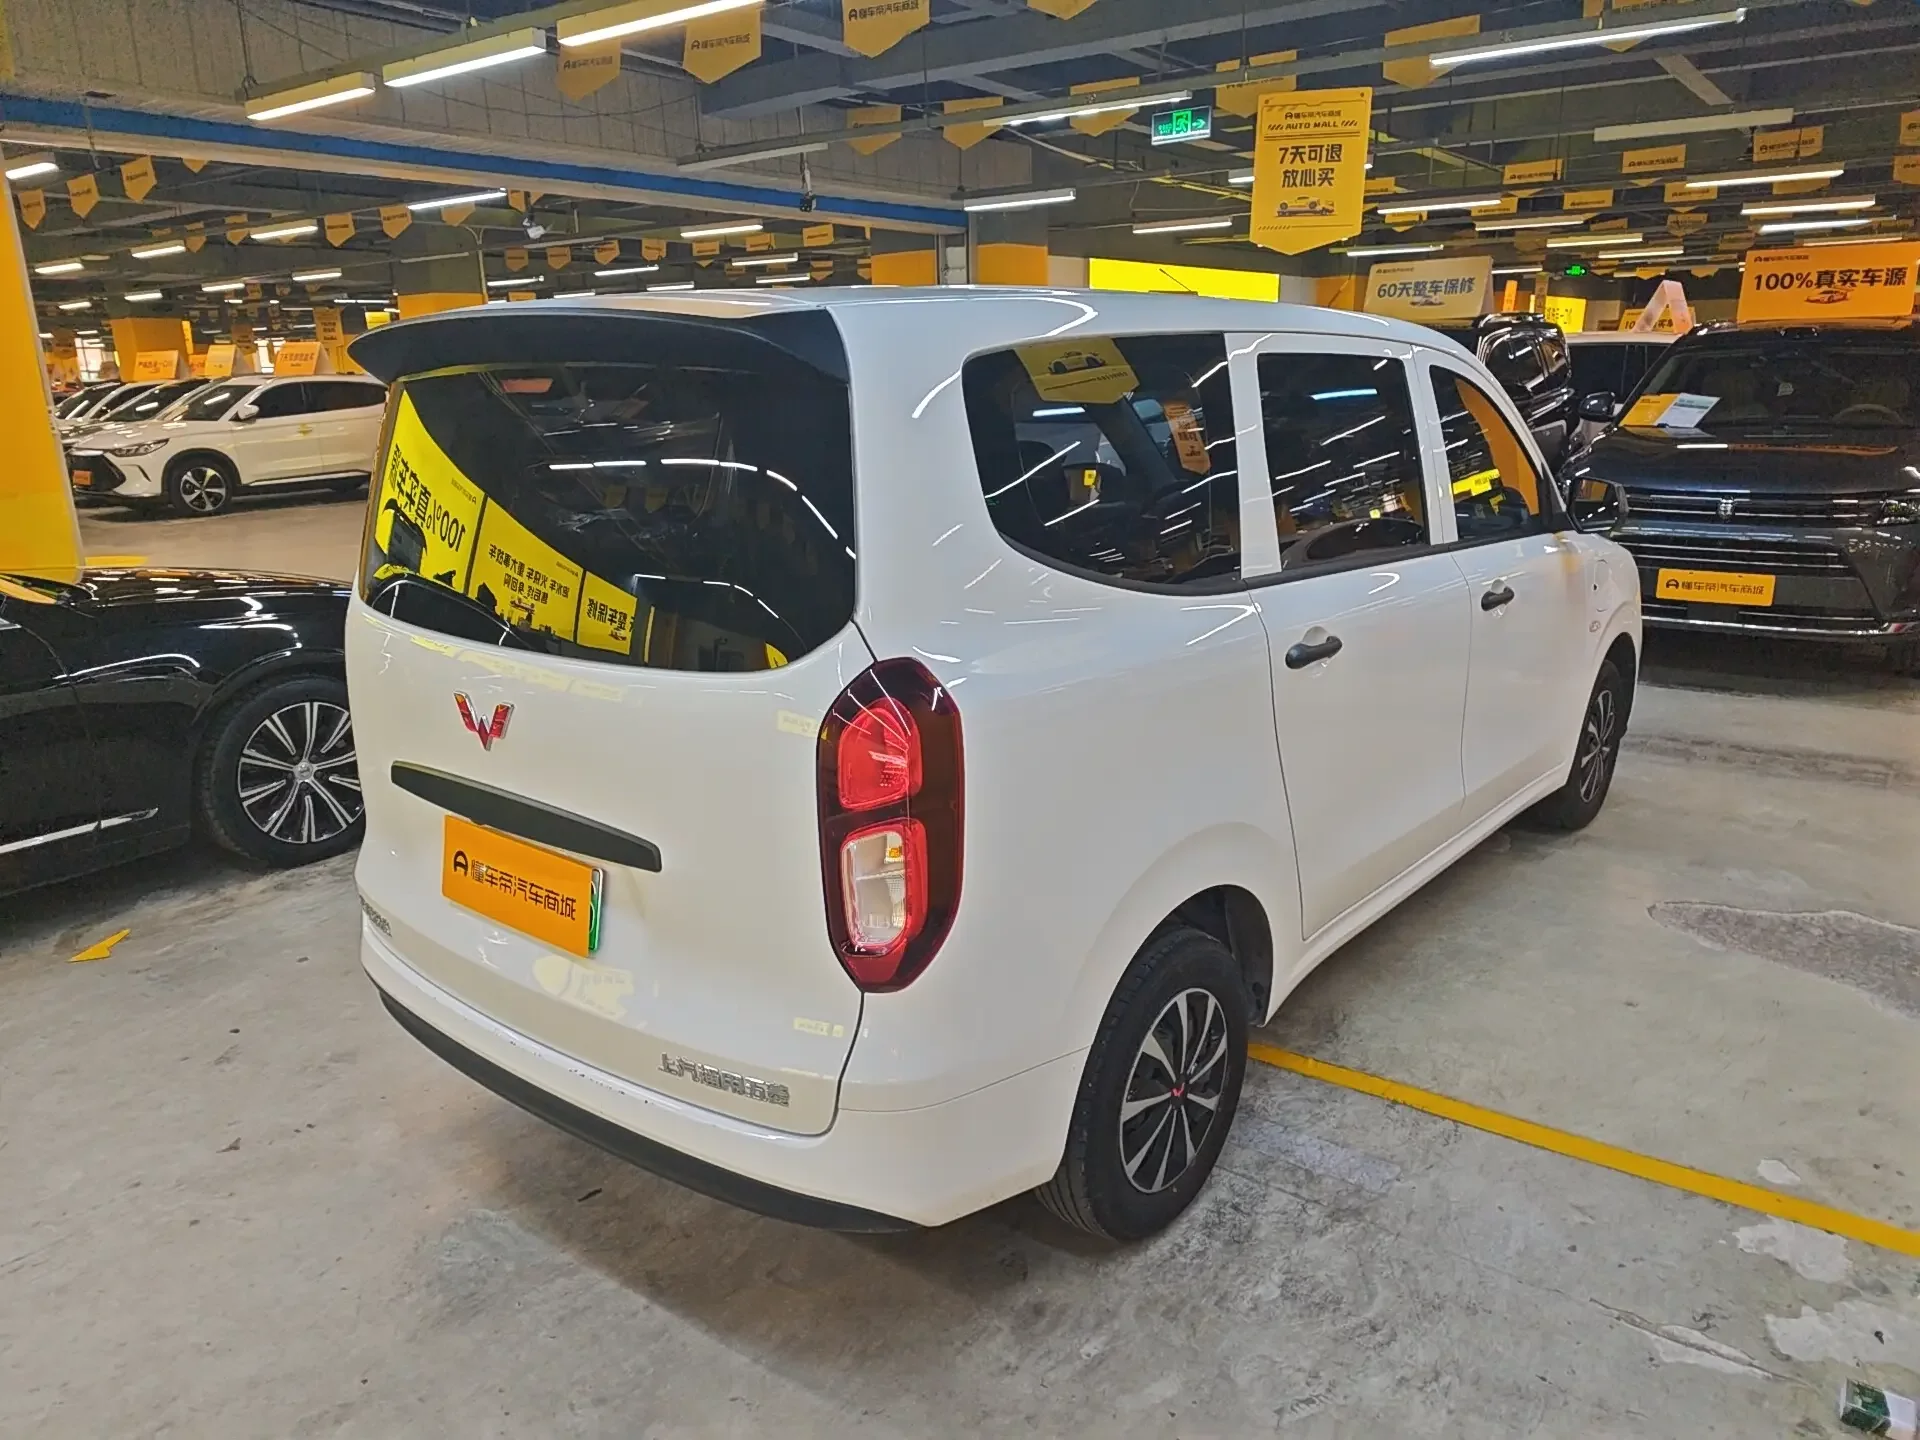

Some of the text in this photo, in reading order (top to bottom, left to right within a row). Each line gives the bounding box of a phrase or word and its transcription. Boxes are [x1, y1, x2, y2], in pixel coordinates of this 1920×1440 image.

[1285, 120, 1338, 130] AUTO MALL
[1279, 144, 1342, 164] 7天可退
[1282, 167, 1335, 188] 放心买
[1377, 277, 1476, 299] 60天整车保修
[1754, 266, 1908, 291] 100%真实车源
[471, 859, 577, 921] 懂车帝汽车商城
[658, 1052, 790, 1108] 上汽通用五菱
